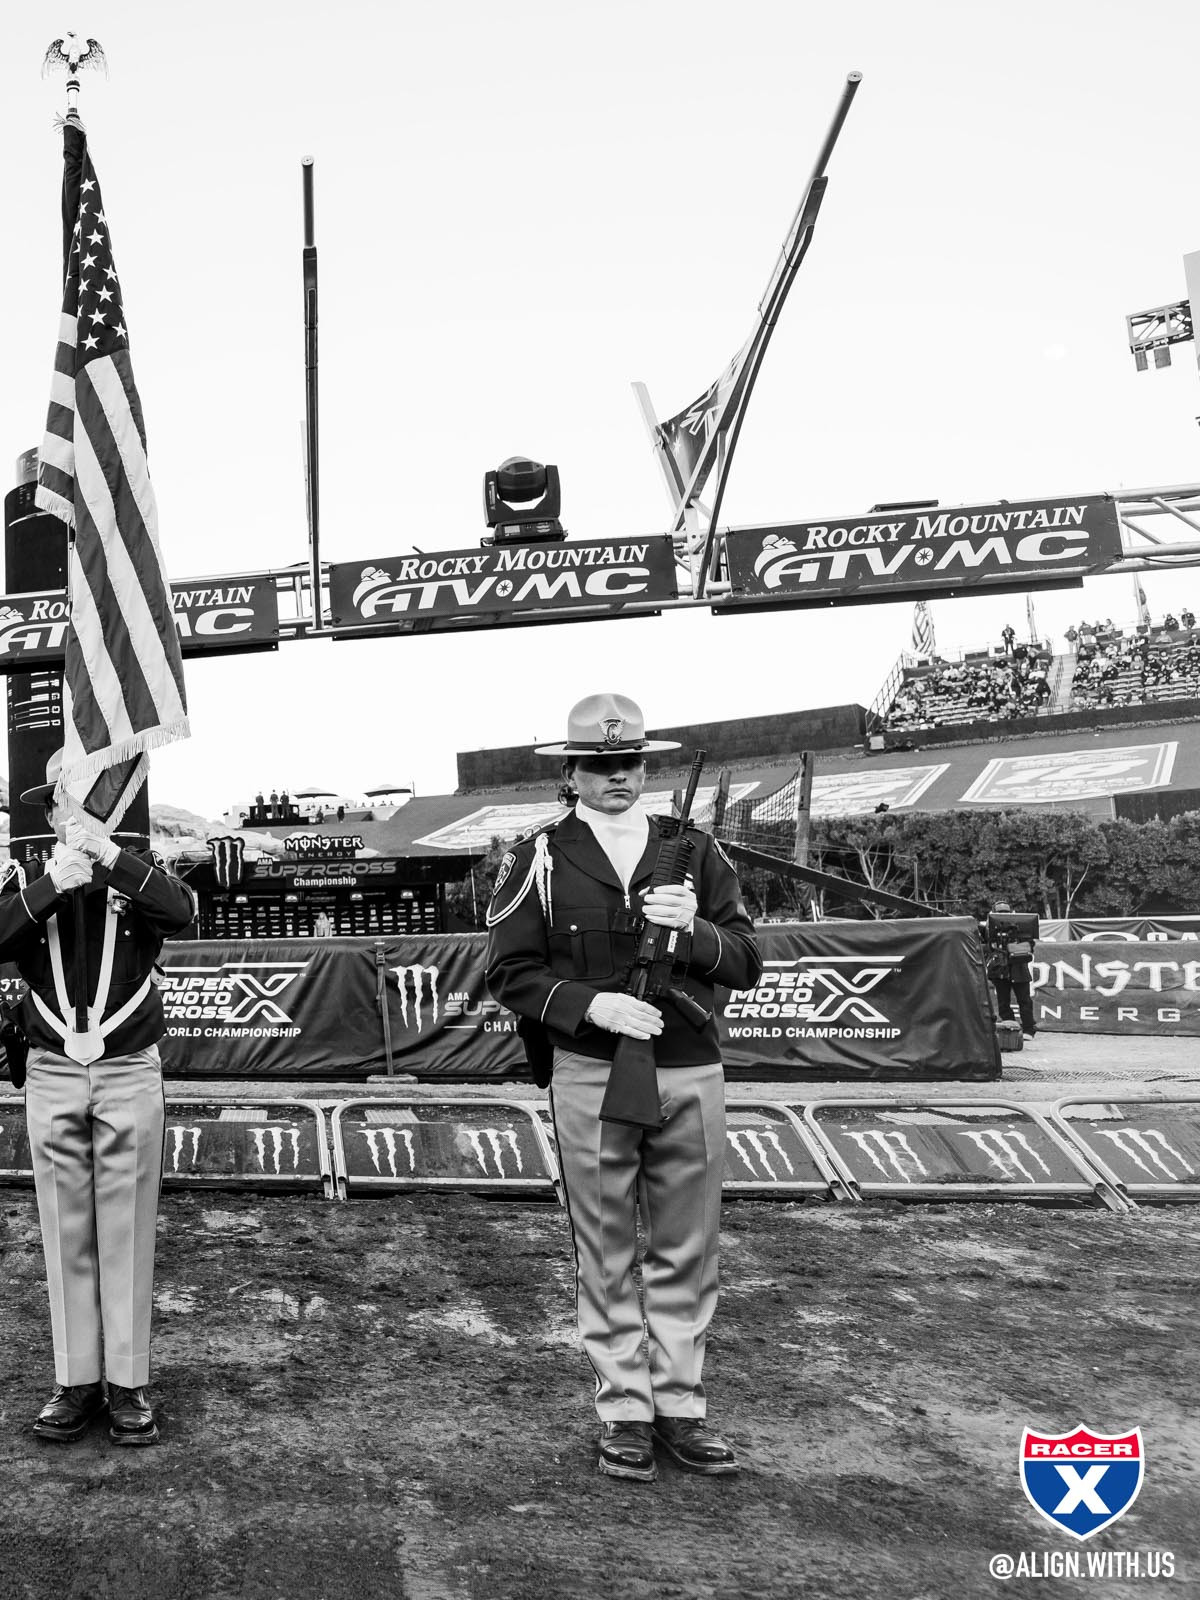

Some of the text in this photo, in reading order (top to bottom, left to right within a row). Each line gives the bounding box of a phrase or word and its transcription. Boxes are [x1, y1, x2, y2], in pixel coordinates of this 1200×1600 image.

[802, 505, 1088, 551] ROCKY MOUNTAIN
[396, 544, 650, 581] ROCKY MOUNTAIN
[172, 586, 255, 608] NTAIN
[286, 837, 363, 851] MONSTER
[253, 861, 397, 877] SUPERCROSS
[257, 858, 273, 866] AMA
[294, 876, 357, 887] Championship
[759, 972, 816, 987] PER
[1029, 953, 1200, 996] ONSTE
[157, 977, 236, 991] SUPER
[162, 992, 232, 1005] MOTO
[447, 992, 470, 1001] AMA
[729, 988, 813, 1003] MOTO
[723, 1003, 816, 1018] CROSS
[1010, 1004, 1200, 1022] ENERG
[204, 1027, 302, 1038] CHAMPIONSHIP
[728, 1027, 902, 1039] WORLD CHAMPIONSHIP
